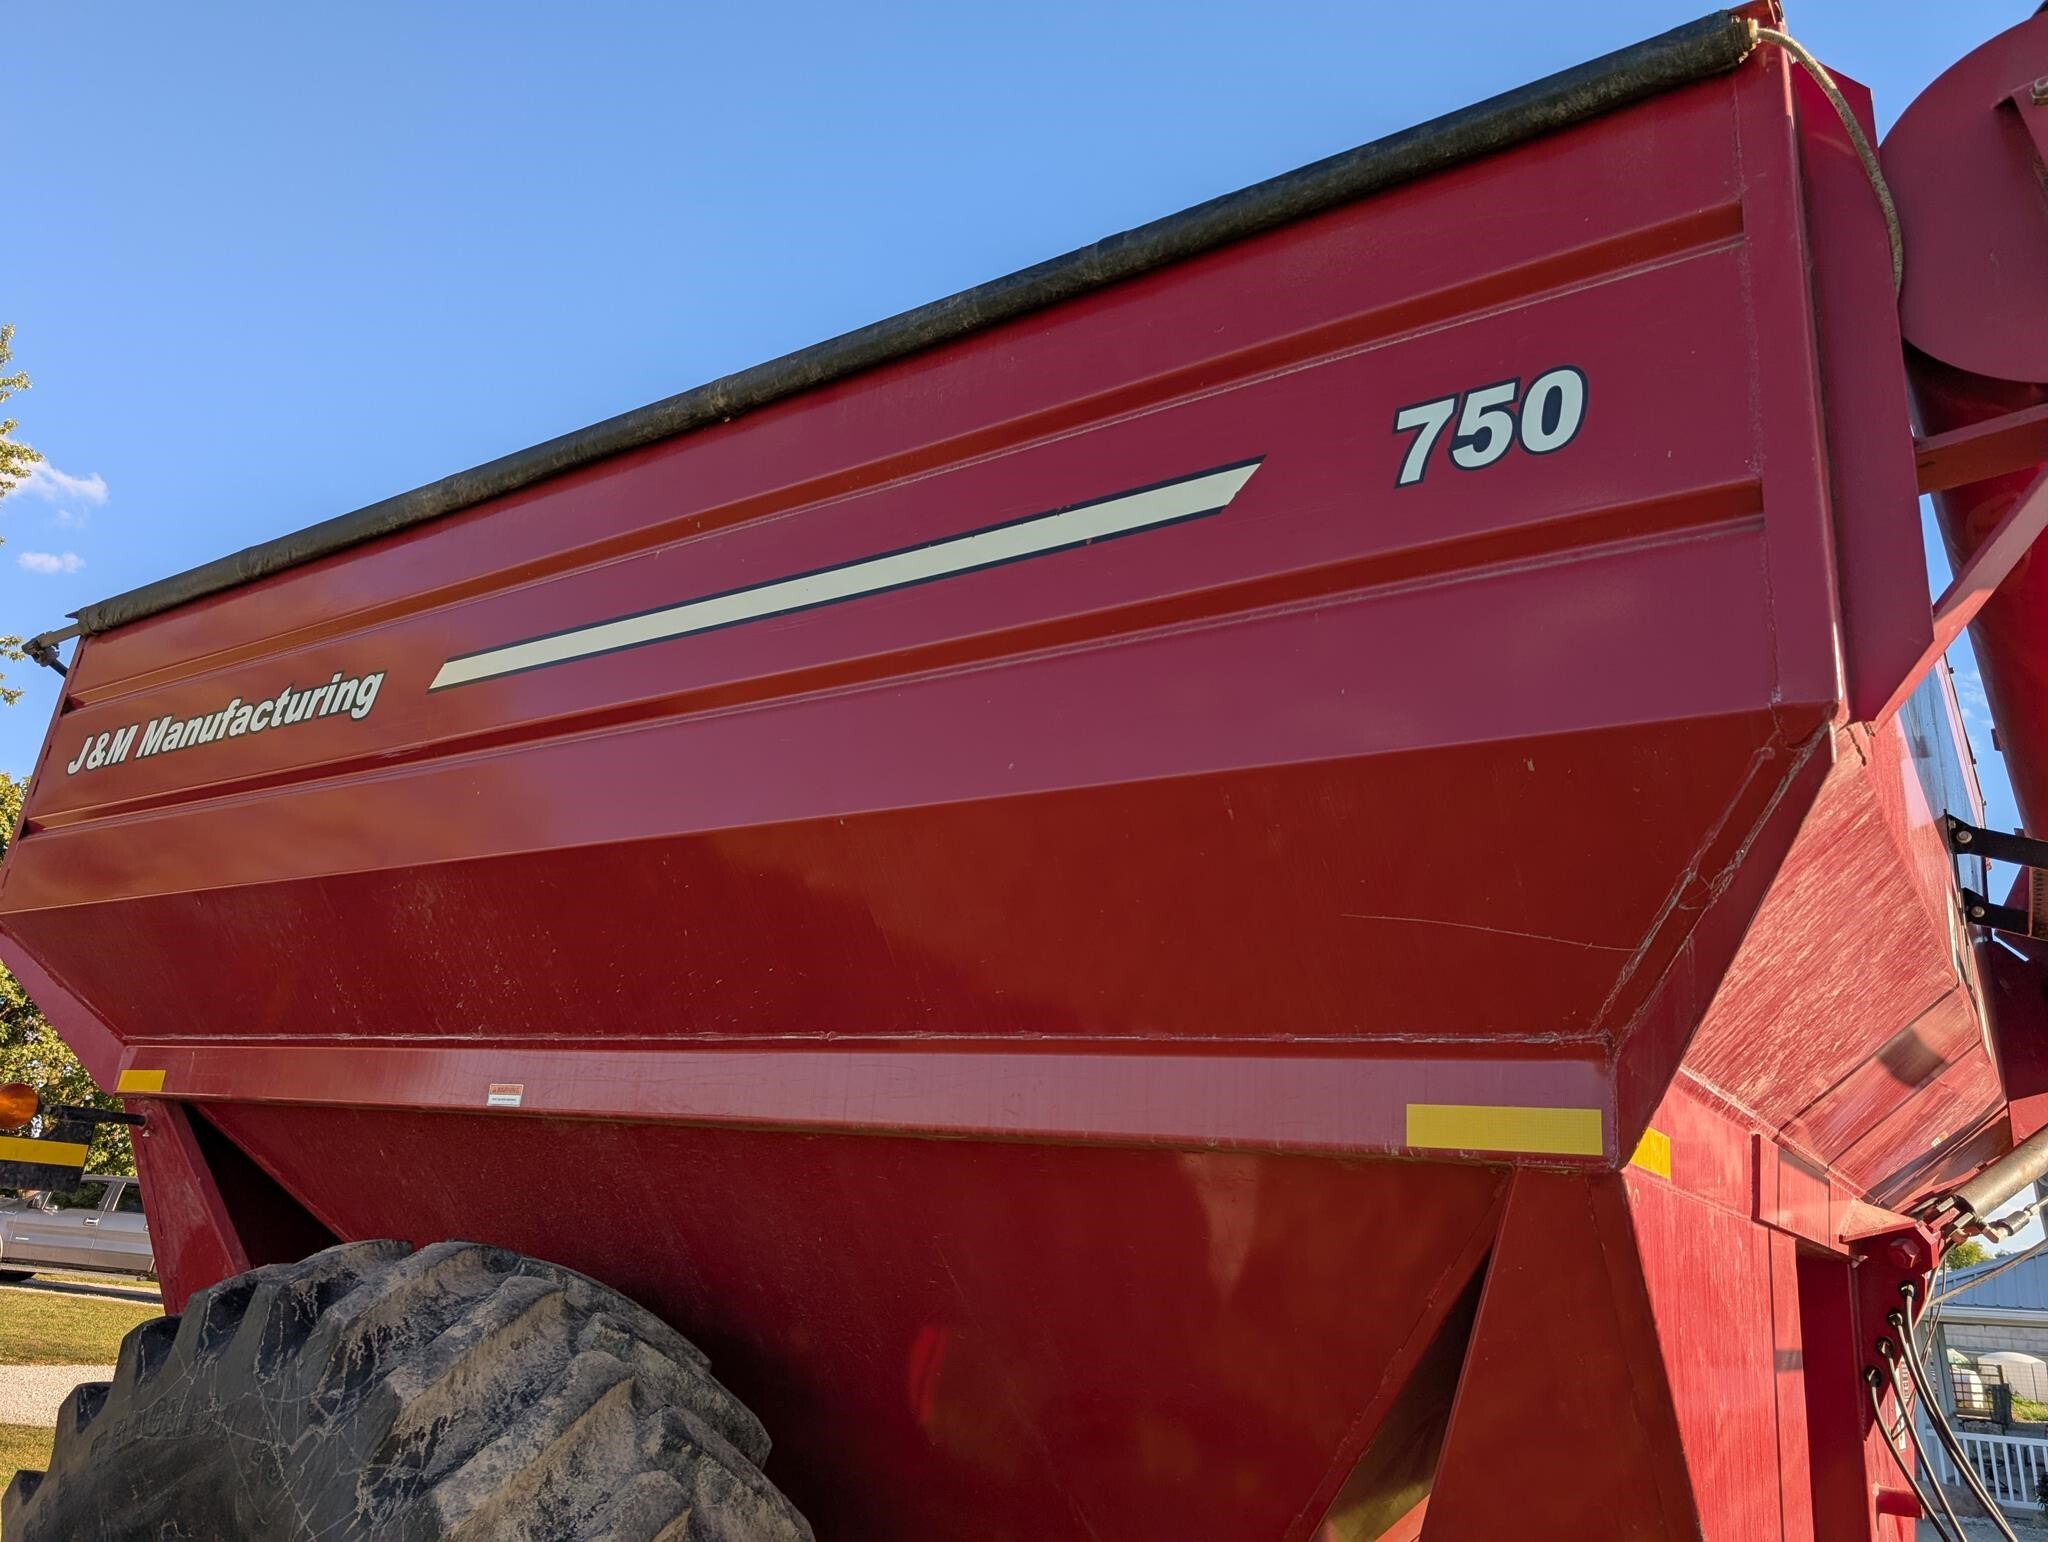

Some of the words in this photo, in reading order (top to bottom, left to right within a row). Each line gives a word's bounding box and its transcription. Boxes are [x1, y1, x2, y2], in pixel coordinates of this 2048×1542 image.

[1394, 366, 1587, 487] 750
[66, 724, 137, 775] J&M
[135, 671, 386, 759] Manufacturing
